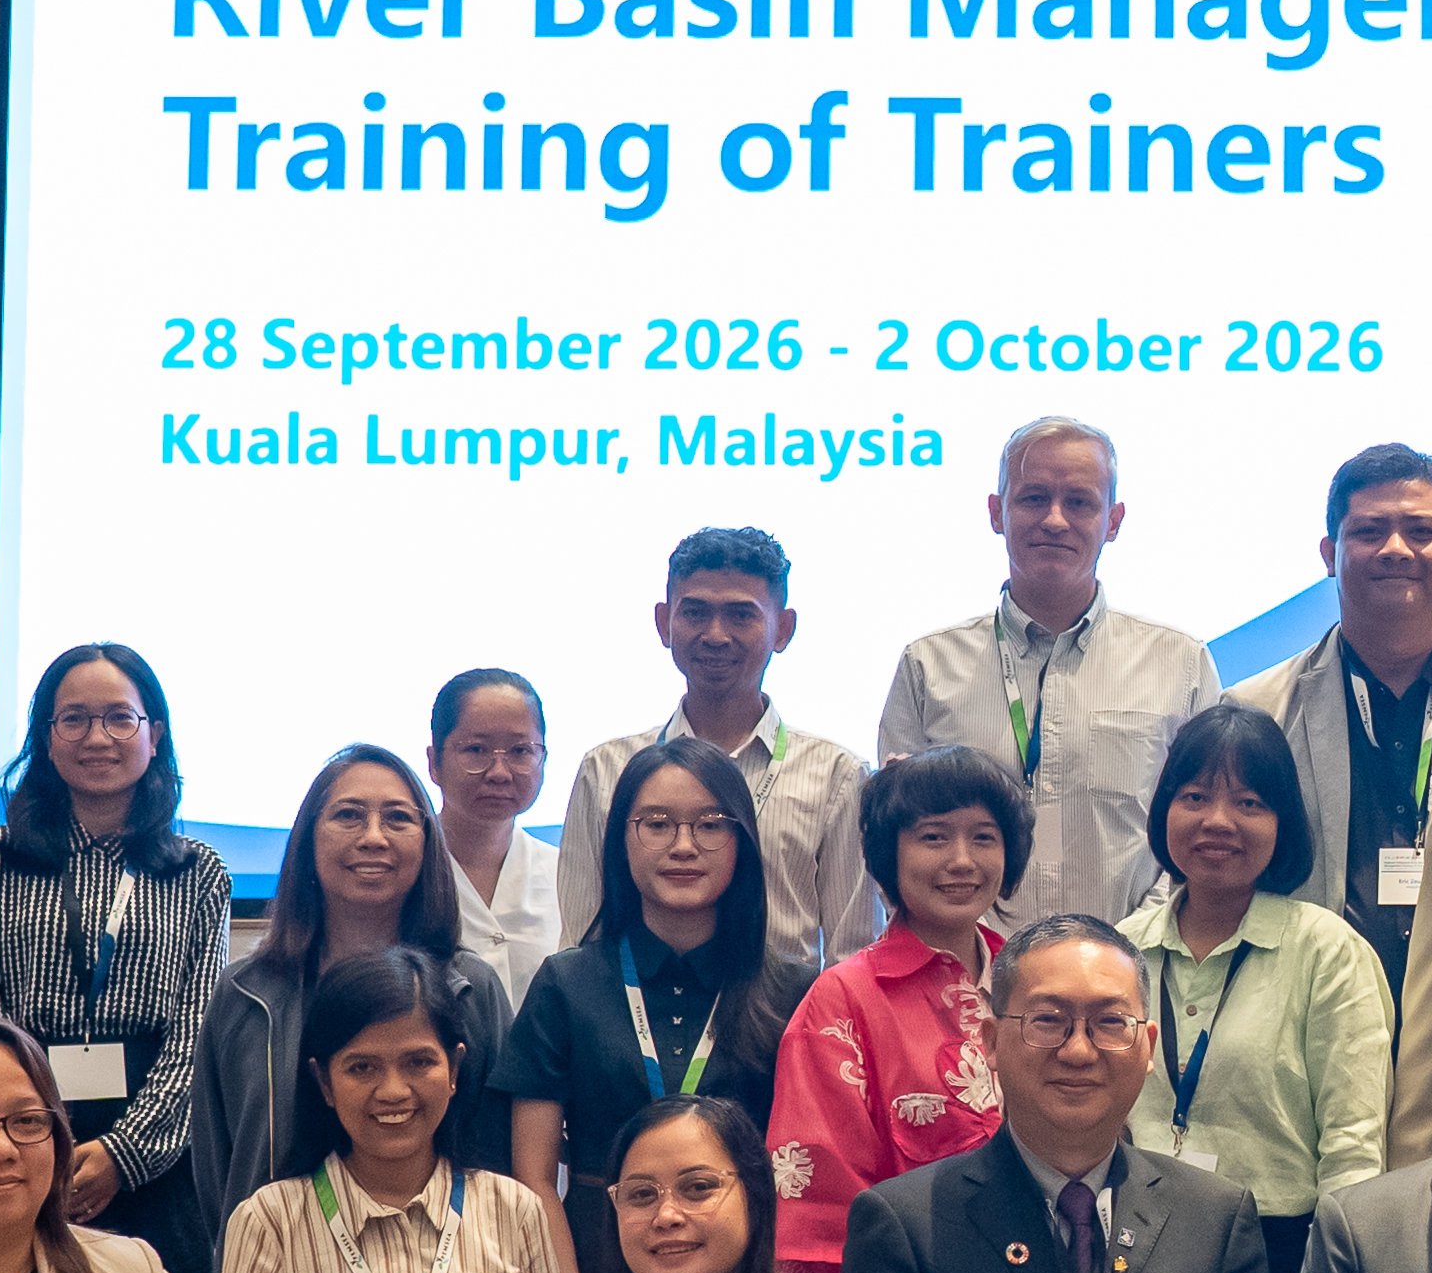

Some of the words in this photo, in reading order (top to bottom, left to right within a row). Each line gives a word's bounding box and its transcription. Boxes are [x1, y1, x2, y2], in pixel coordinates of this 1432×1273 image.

[163, 91, 669, 223] Training
[719, 89, 849, 193] of
[888, 92, 1385, 195] Trainers
[161, 318, 237, 370] 28
[262, 316, 622, 386] September
[644, 318, 803, 371] 2026
[829, 346, 849, 356] -
[876, 319, 909, 371] 2
[936, 317, 1202, 372] October
[1225, 320, 1383, 373] 2026
[162, 411, 338, 465] Kuala
[367, 414, 629, 481] Lumpur,
[659, 412, 942, 482] Malaysia
[340, 1233, 358, 1260] PEMSEA
[441, 1233, 452, 1261] PEMSEA
